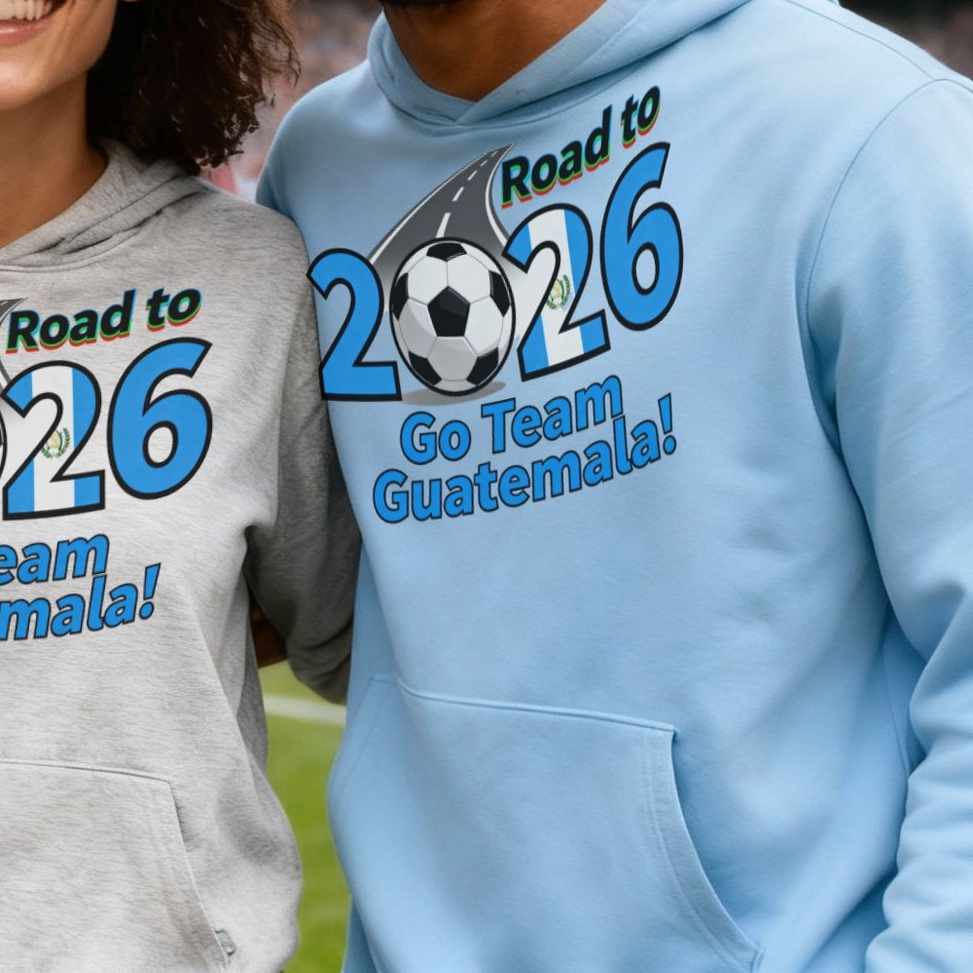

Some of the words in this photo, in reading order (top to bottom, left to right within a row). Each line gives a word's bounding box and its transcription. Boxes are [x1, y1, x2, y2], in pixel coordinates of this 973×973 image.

[501, 104, 612, 209] Road
[621, 85, 661, 148] to
[6, 288, 136, 353] Road
[145, 286, 203, 326] to
[373, 393, 677, 524] Guatemala!
[400, 411, 472, 465] Go
[481, 375, 623, 454] Team
